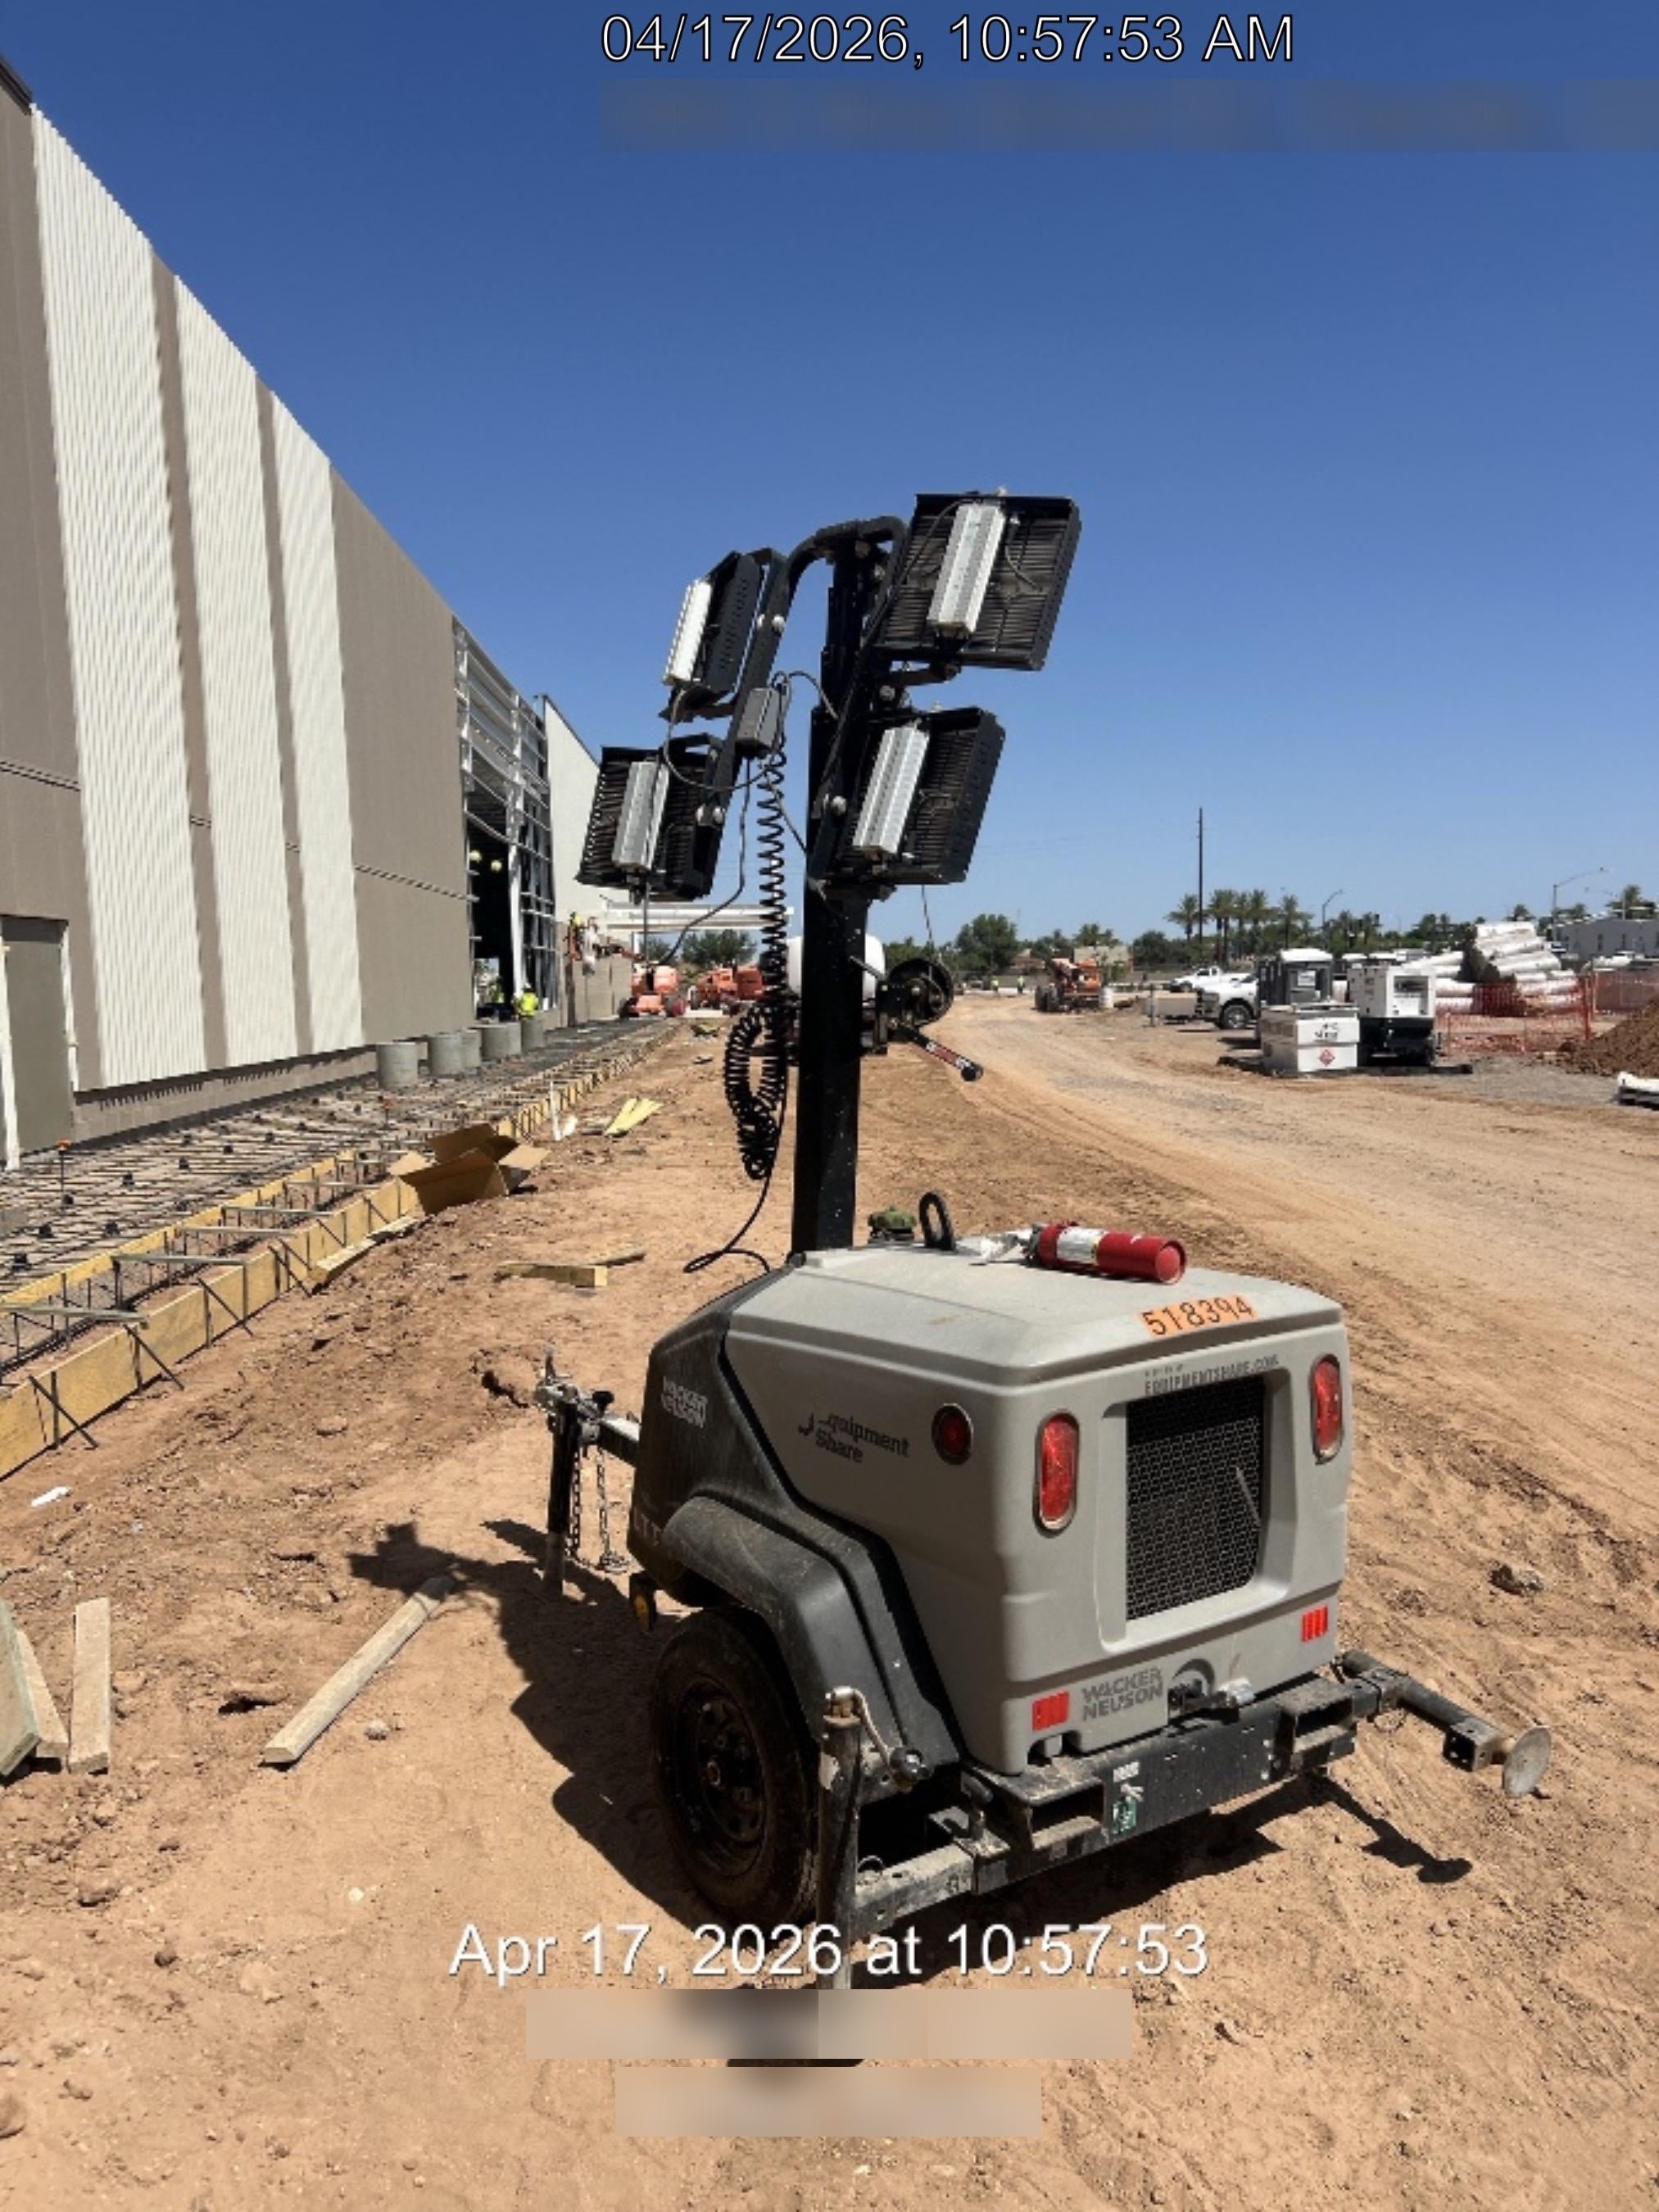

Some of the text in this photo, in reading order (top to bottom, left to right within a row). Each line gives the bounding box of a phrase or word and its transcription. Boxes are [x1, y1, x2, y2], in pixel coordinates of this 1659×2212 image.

[1141, 1295, 1254, 1336] 518394
[815, 1428, 863, 1462] Share
[1081, 1666, 1163, 1703] WACKER
[1082, 1680, 1164, 1722] NEUSON
